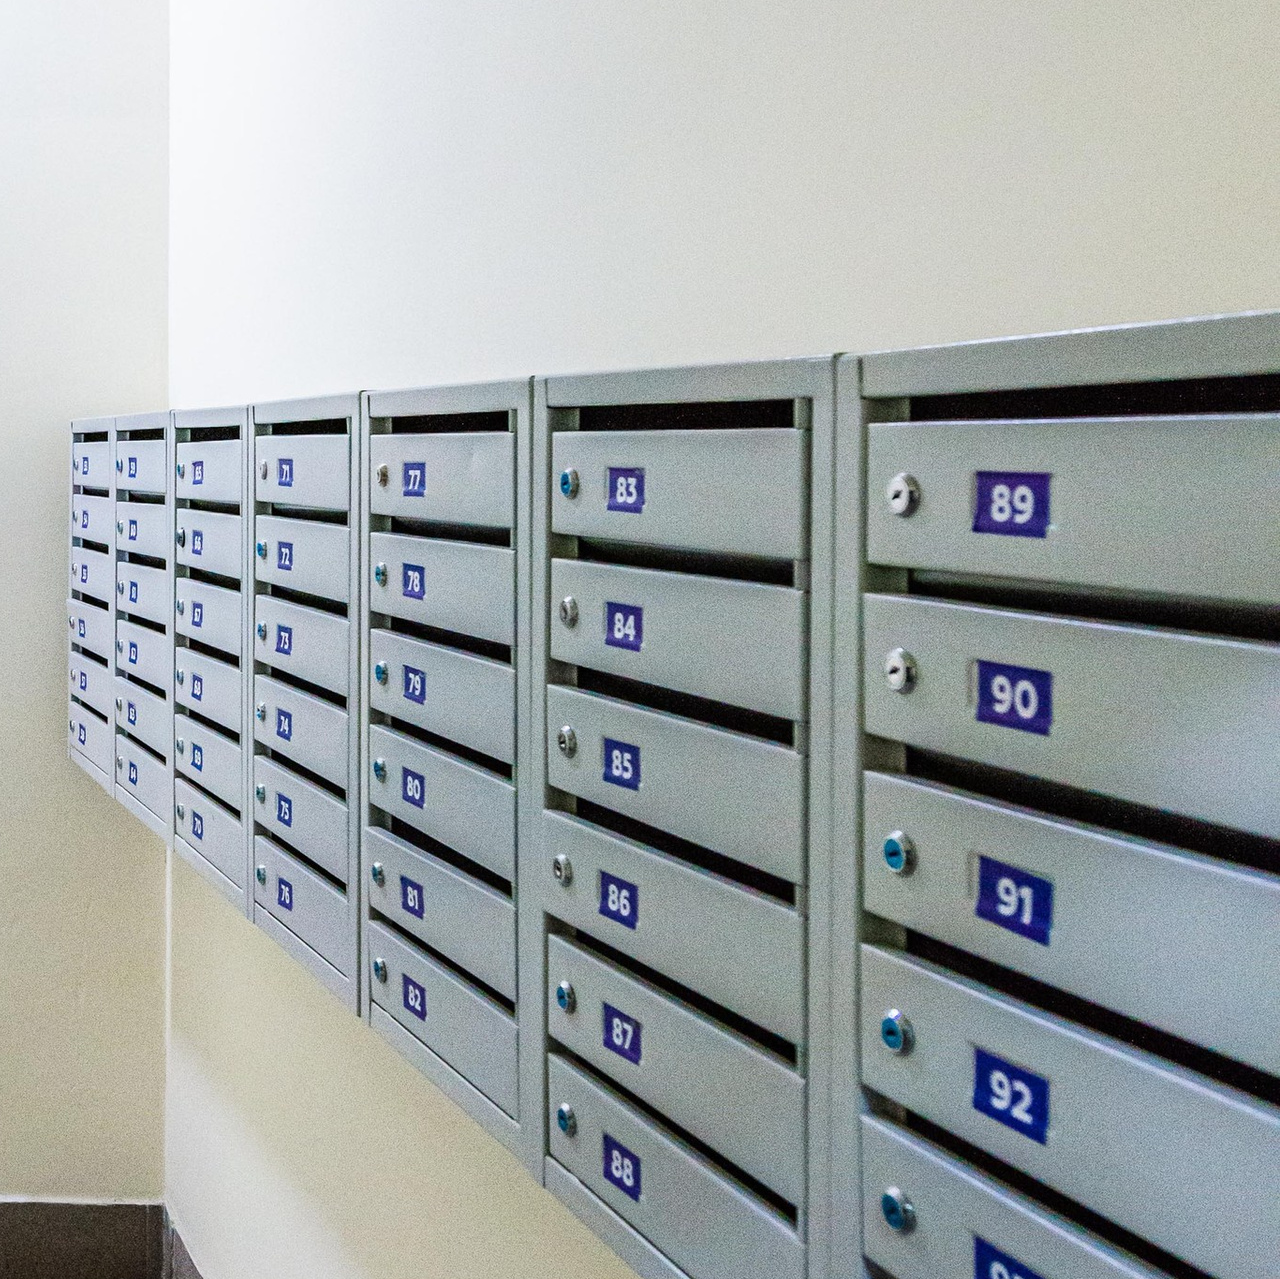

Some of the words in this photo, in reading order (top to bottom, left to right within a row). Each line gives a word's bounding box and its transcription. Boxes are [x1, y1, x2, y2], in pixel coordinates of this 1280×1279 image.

[282, 464, 290, 481] 71
[408, 470, 420, 490] 77
[616, 477, 637, 504] 83
[990, 484, 1035, 525] 89
[281, 547, 290, 565] 72
[408, 571, 420, 592] 78
[614, 613, 635, 641] 84
[280, 631, 289, 649] 73
[409, 673, 421, 695] 79
[991, 675, 1038, 720] 90
[280, 715, 289, 734] 74
[612, 750, 632, 779] 85
[407, 776, 420, 799] 80
[280, 801, 289, 820] 75
[281, 885, 289, 904] 76
[407, 886, 418, 909] 81
[608, 884, 630, 916] 86
[996, 877, 1033, 925] 91
[409, 985, 421, 1011] 82
[613, 1018, 632, 1049] 87
[990, 1070, 1033, 1124] 92
[611, 1150, 633, 1186] 88
